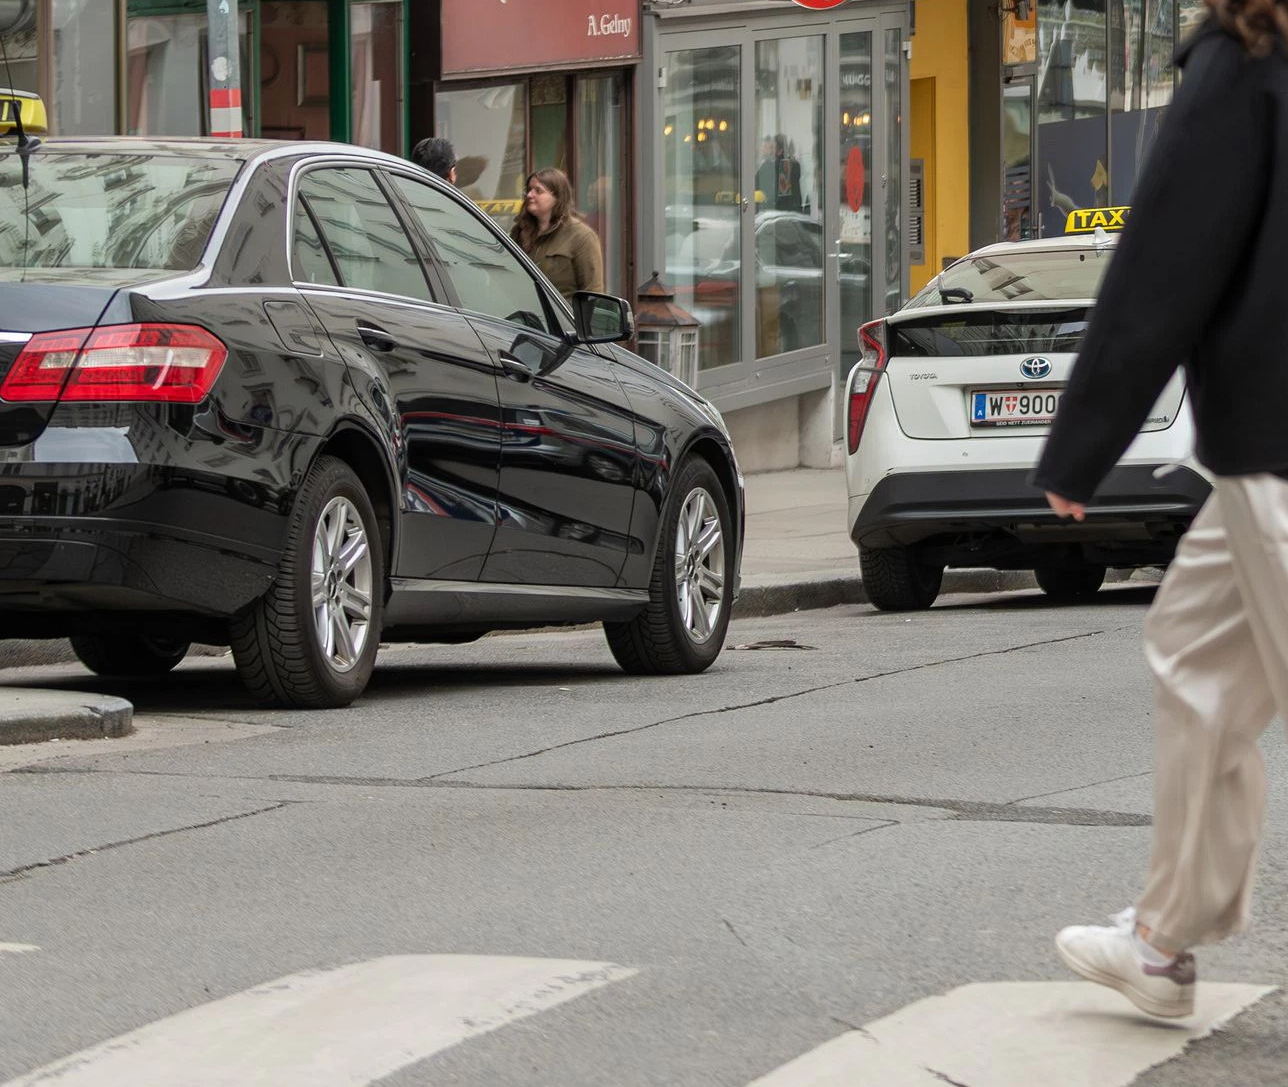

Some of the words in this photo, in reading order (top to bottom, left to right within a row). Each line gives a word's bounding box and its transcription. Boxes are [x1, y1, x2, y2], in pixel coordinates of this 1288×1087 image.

[1077, 209, 1131, 228] TAX
[989, 396, 1003, 416] W
[1019, 394, 1060, 415] 900
